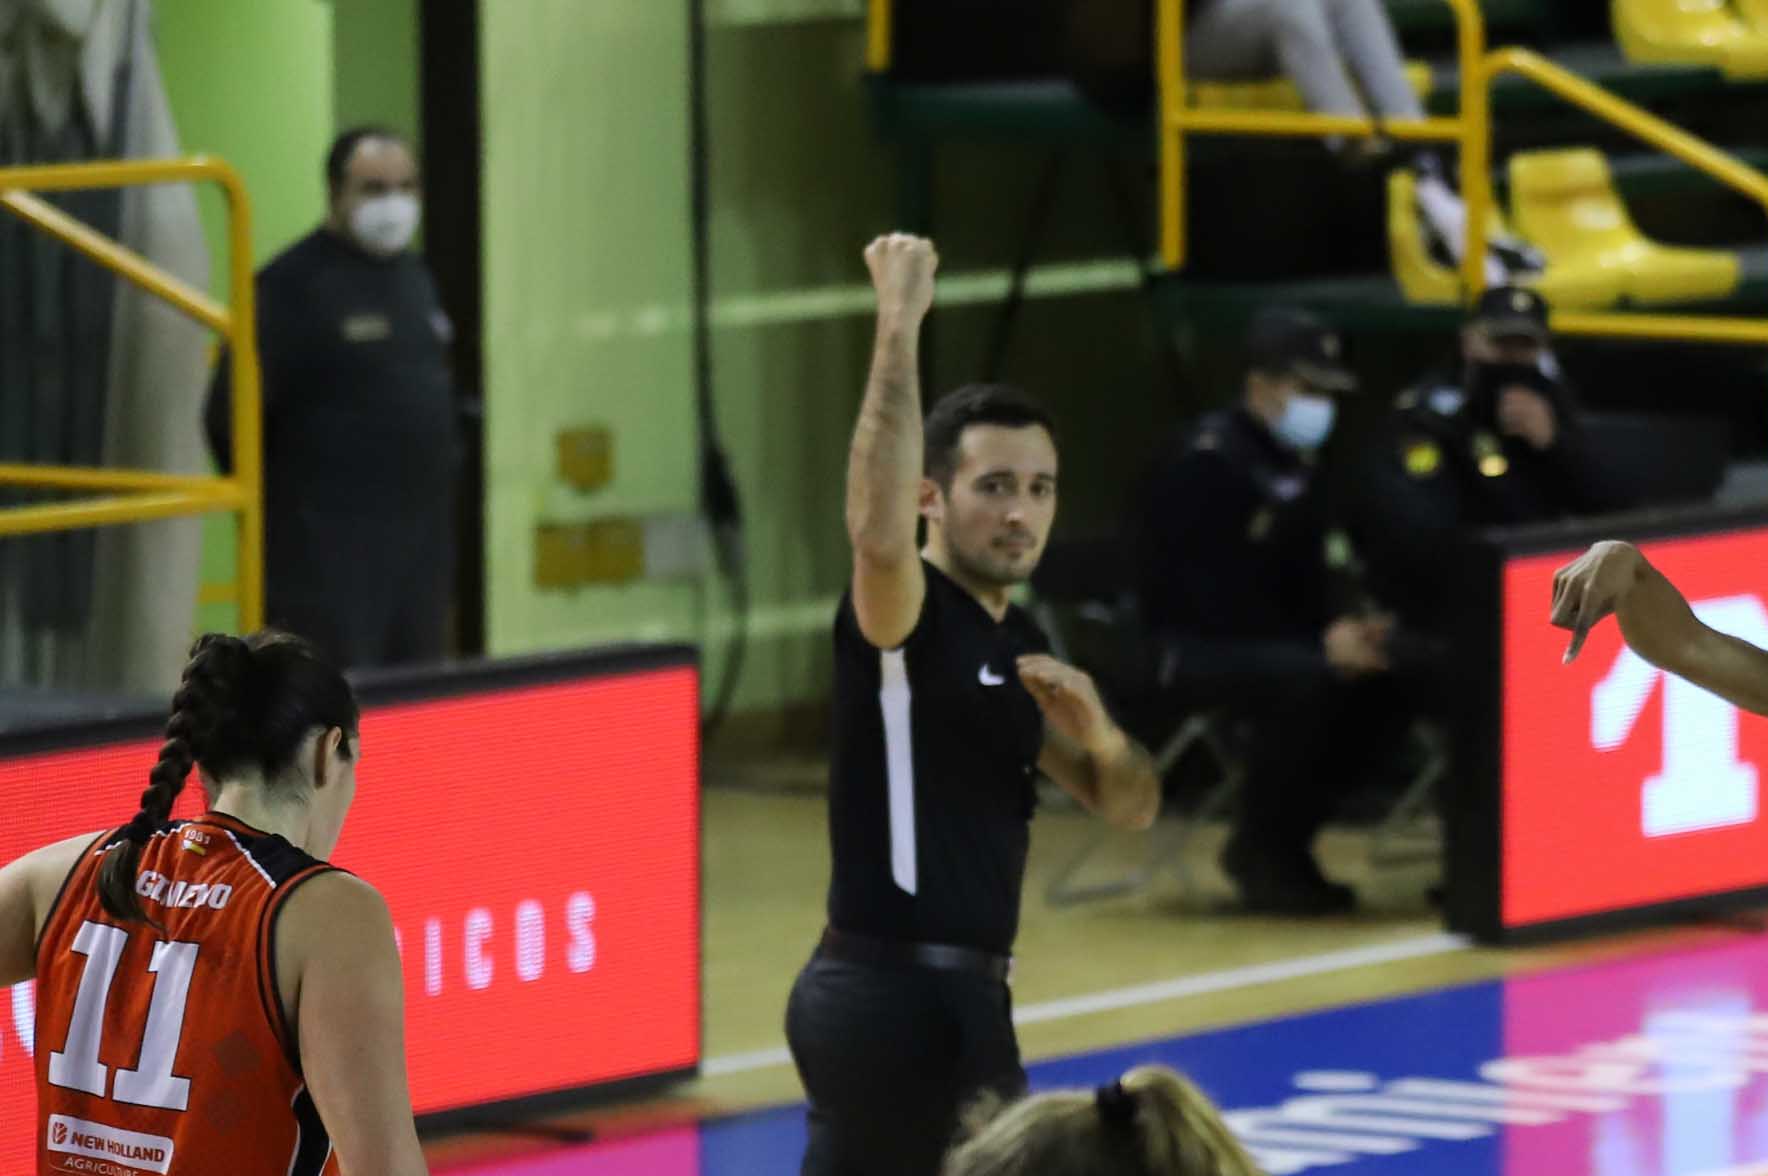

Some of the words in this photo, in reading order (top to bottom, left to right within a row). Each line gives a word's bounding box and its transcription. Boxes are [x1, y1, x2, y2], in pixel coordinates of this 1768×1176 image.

[47, 919, 202, 1112] 11
[70, 1131, 105, 1150] NEW
[107, 1140, 166, 1163] HOLLAND
